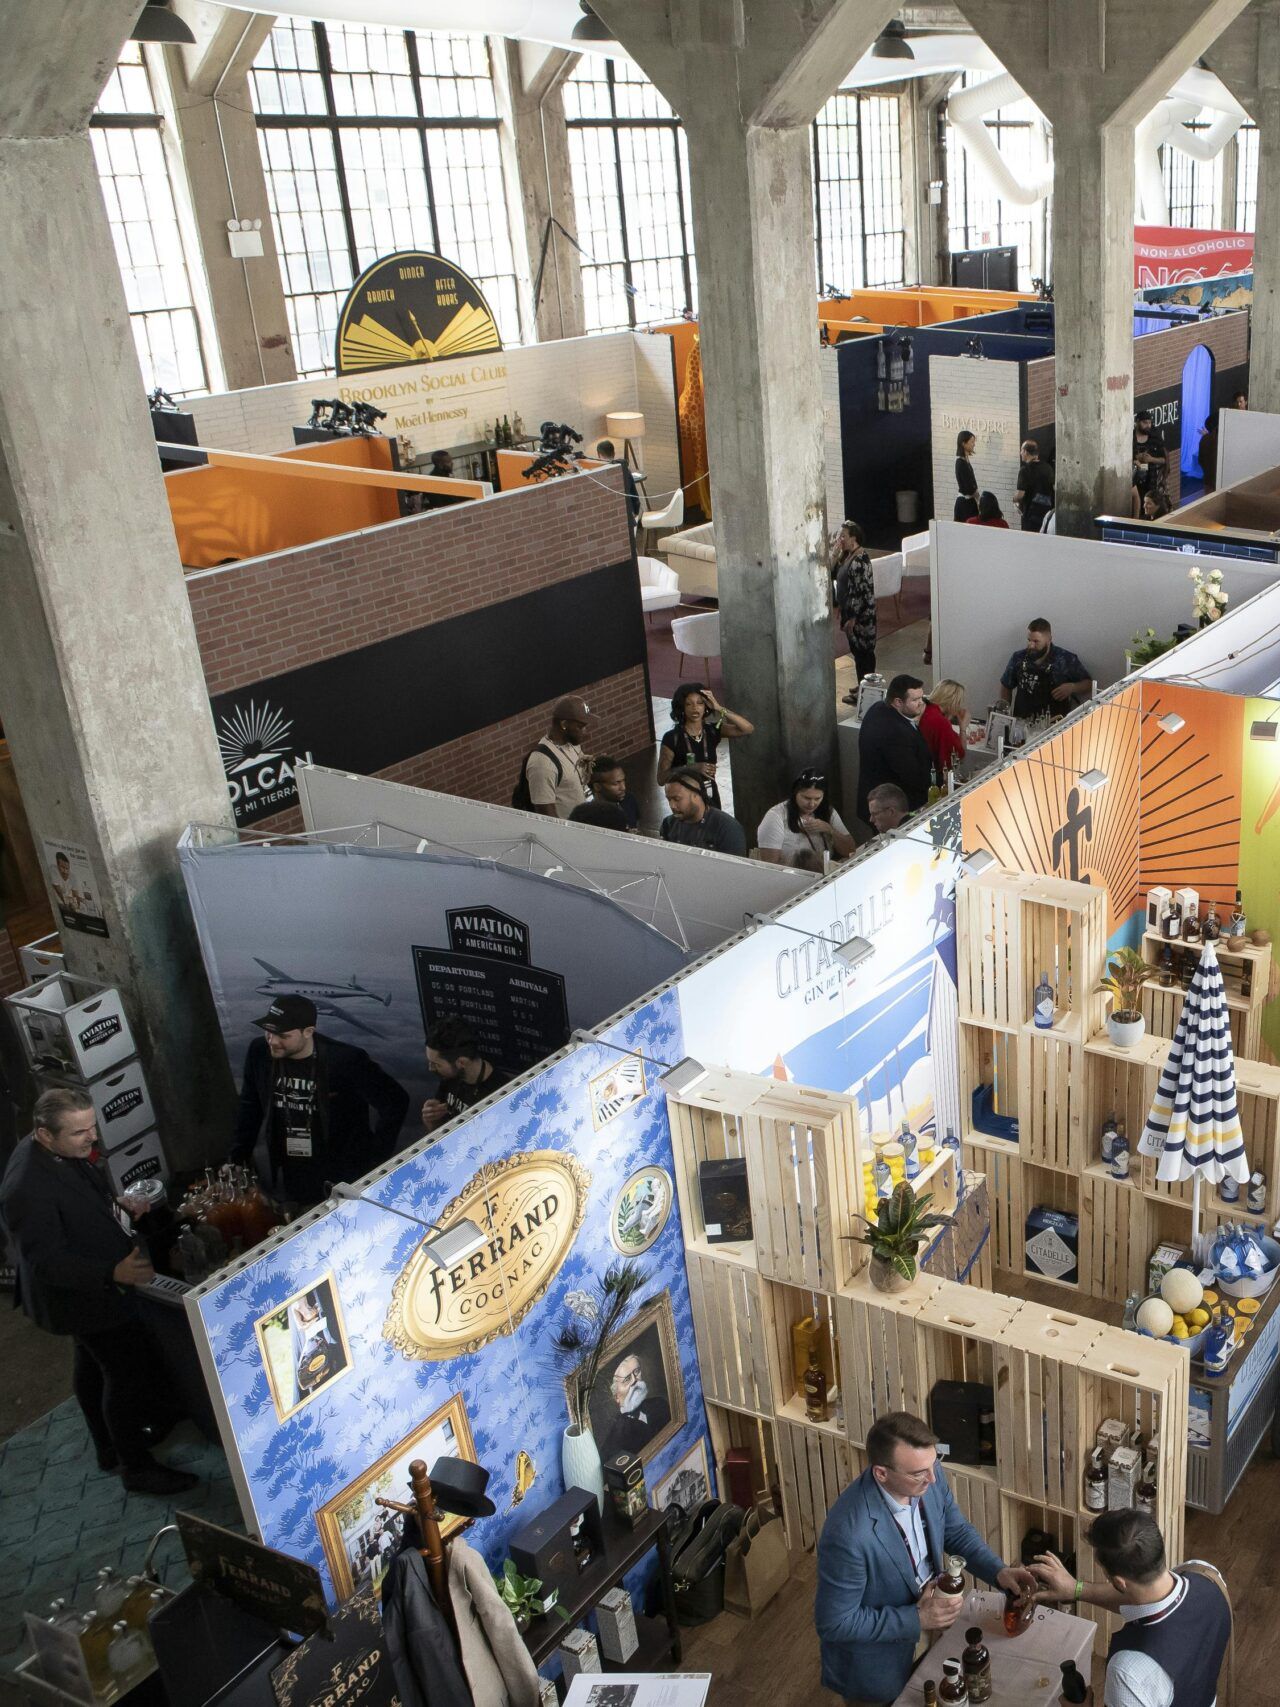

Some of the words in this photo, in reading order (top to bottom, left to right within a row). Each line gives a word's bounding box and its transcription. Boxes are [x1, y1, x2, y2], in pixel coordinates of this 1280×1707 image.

[1140, 239, 1246, 258] NON-ALCOHOLIC
[399, 266, 425, 280] DINNER
[435, 278, 456, 290] AFTER
[367, 289, 395, 304] BRUNCH
[437, 293, 459, 306] HOURS
[340, 382, 417, 402] BROOKLYN
[421, 374, 468, 391] SOCIAL
[471, 366, 508, 383] CLUB
[423, 407, 469, 426] Hennessy
[245, 801, 258, 812] MI
[261, 784, 298, 806] TIERRA
[454, 916, 523, 943] AVIATION
[465, 938, 502, 953] AMERICAN
[504, 945, 516, 956] GIN
[429, 964, 486, 979] DEPARTURES
[509, 977, 548, 994] ARRIVALS
[805, 982, 823, 1004] GIN
[82, 1017, 118, 1041] AVIATION
[105, 1089, 140, 1114] AVIATION
[123, 1159, 158, 1183] AVIATION
[429, 1194, 559, 1325] FERRAND
[1031, 1245, 1070, 1264] CITADELLE
[459, 1242, 543, 1315] COGNAC
[309, 1650, 381, 1707] RRAND
